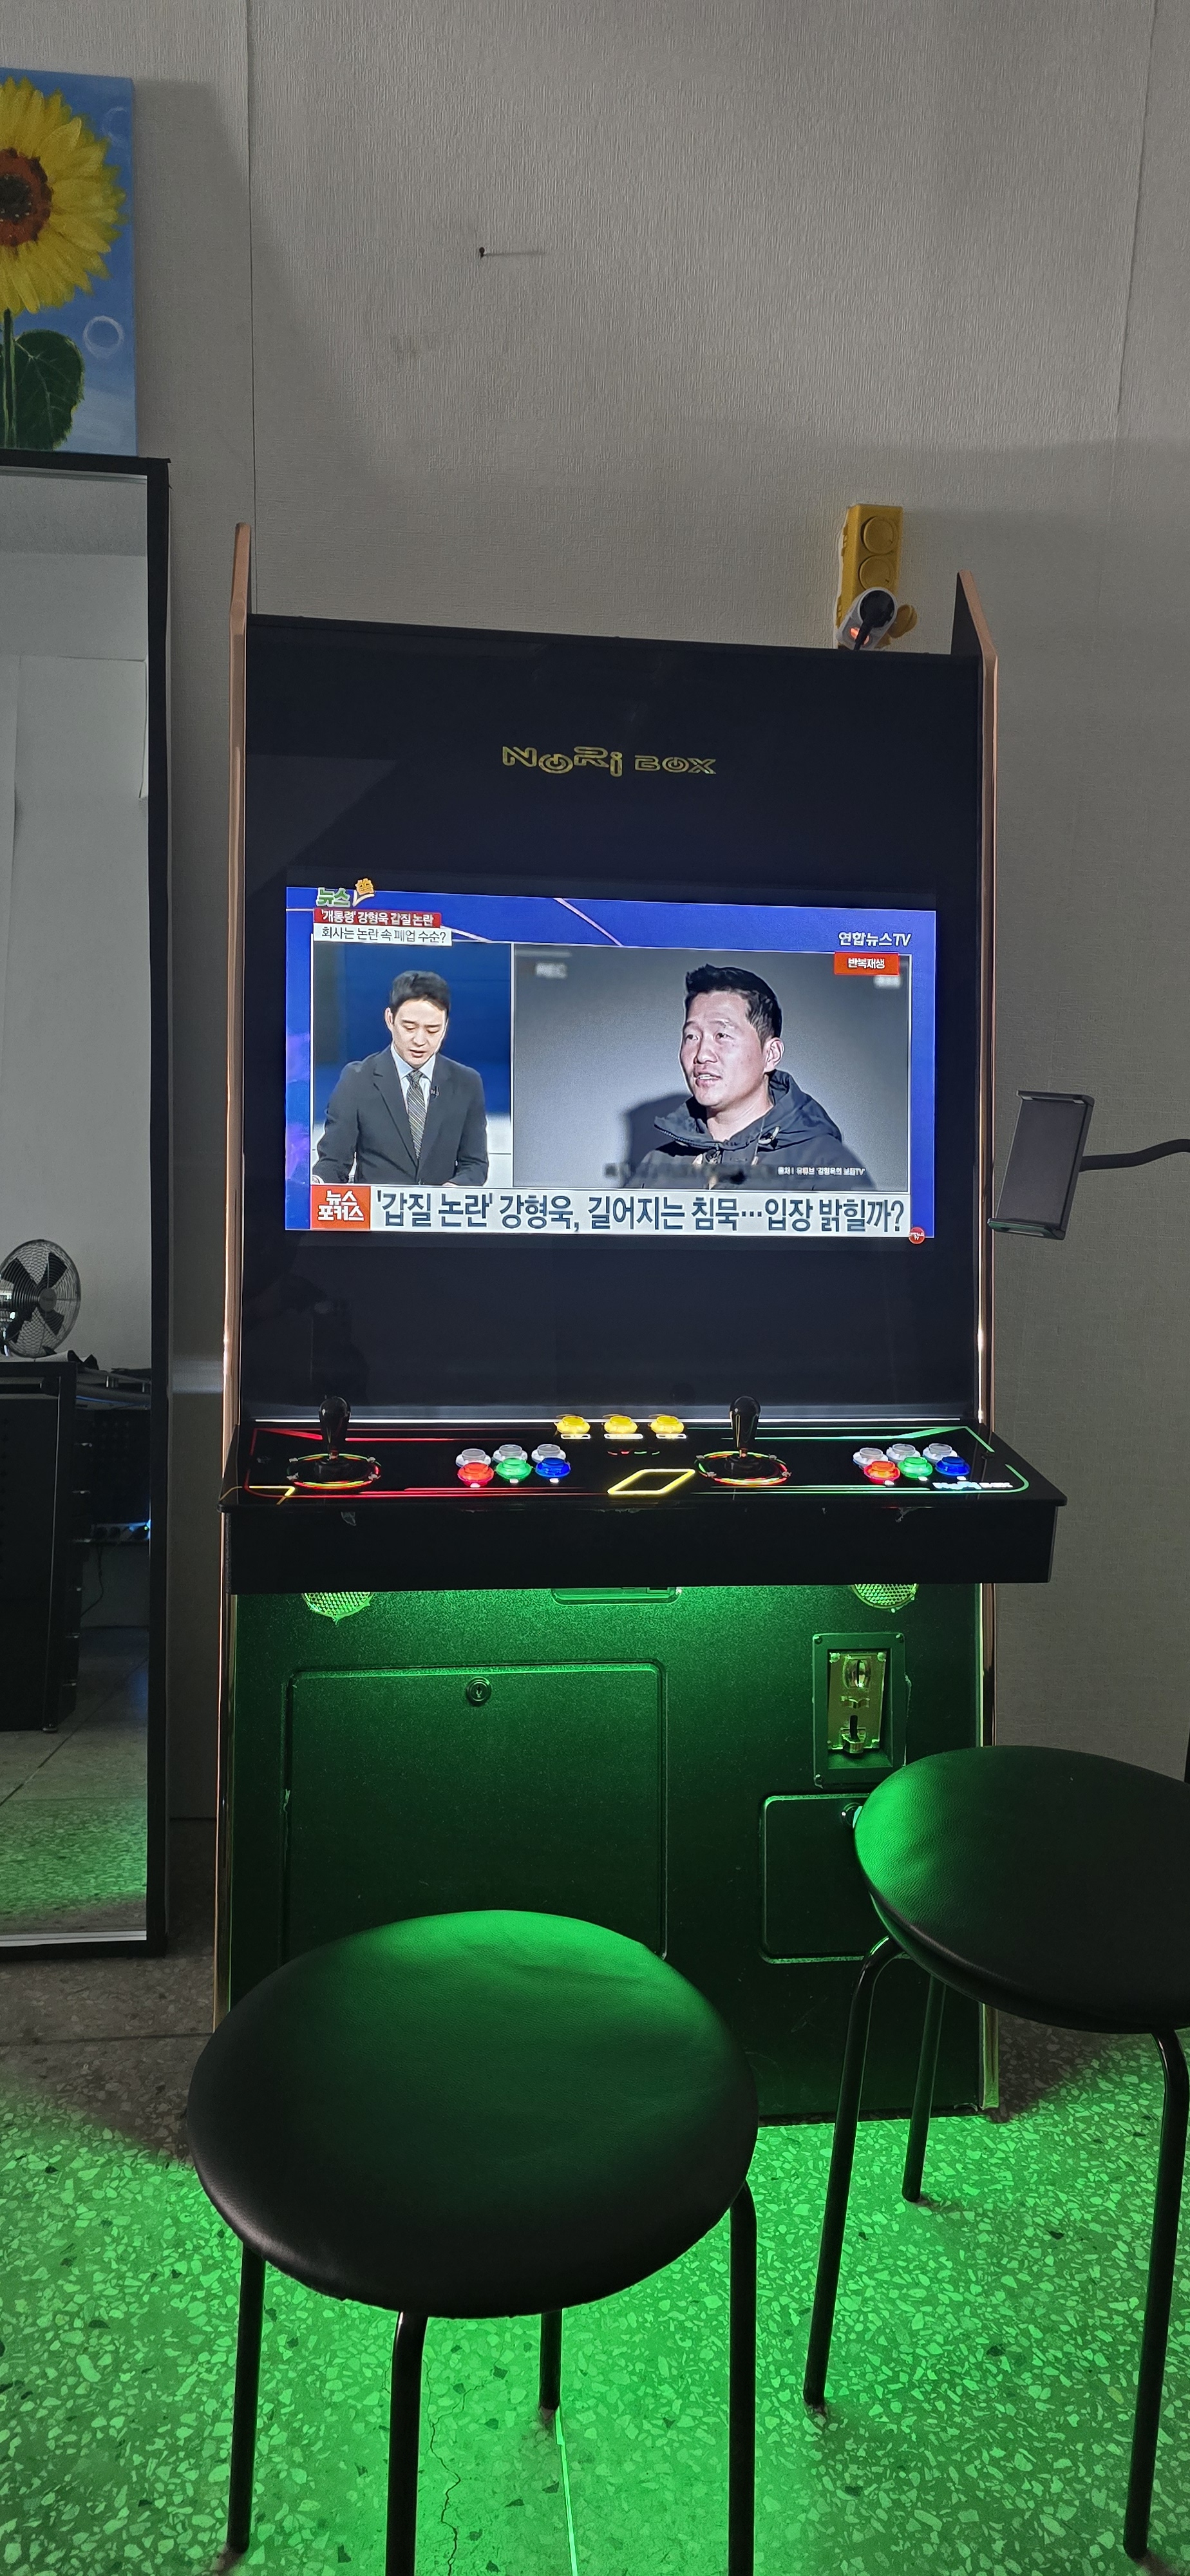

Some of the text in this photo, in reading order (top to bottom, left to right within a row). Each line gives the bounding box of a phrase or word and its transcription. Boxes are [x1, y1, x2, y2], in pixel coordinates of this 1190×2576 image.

[634, 755, 717, 775] BOX
[316, 887, 350, 907] 뉴스
[357, 911, 389, 925] 강형욱
[390, 913, 411, 925] 갑질
[412, 914, 434, 927] 논란
[322, 926, 355, 940] 회사는
[357, 927, 379, 940] 논란
[381, 929, 392, 942] 속
[418, 931, 446, 943] 수순?
[838, 932, 912, 947] 연합뉴스TV
[847, 958, 885, 969] 반복재생
[326, 1190, 358, 1206] 뉴스
[317, 1204, 364, 1222] 포커스
[377, 1190, 431, 1227] '갑질
[439, 1193, 493, 1227] 논란'
[499, 1195, 580, 1232] 강형욱,
[588, 1195, 686, 1231] 길어지는
[819, 1198, 904, 1233] 밝힐까?
